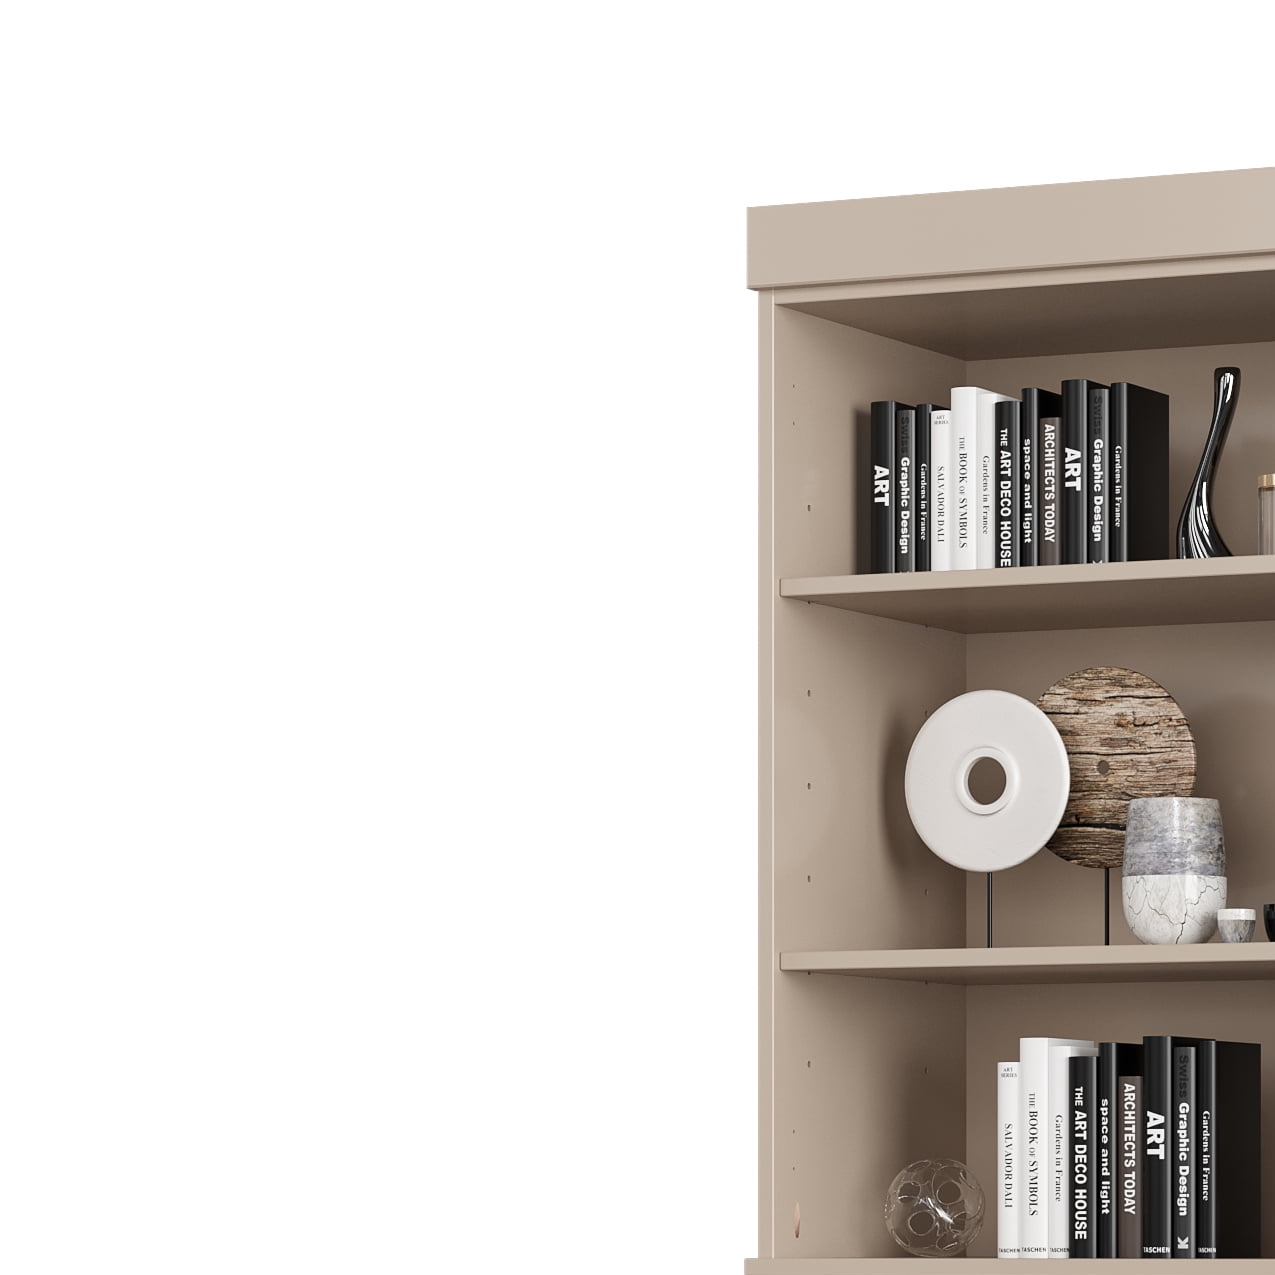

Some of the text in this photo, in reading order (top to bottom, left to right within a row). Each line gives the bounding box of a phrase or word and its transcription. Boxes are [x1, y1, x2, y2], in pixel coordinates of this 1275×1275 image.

[873, 464, 890, 507] ART
[898, 456, 911, 554] Graphic Design
[999, 427, 1013, 569] THE ART DECO HOUSE
[1022, 438, 1033, 544] space and light
[1044, 423, 1056, 543] ARCHITECTS TODAY
[1064, 447, 1082, 492] ART
[1091, 438, 1104, 542] Graphic Design
[1004, 1123, 1013, 1181] SALVADOR
[1074, 1085, 1088, 1240] THE ART DECO HOUSE
[1099, 1098, 1111, 1215] space and light
[1123, 1083, 1136, 1215] ARCHITECTS TODAY
[1146, 1110, 1165, 1160] ART
[1176, 1102, 1190, 1162] Graphic
[1176, 1165, 1190, 1216] Design
[1143, 1246, 1170, 1254] TASCHEN
